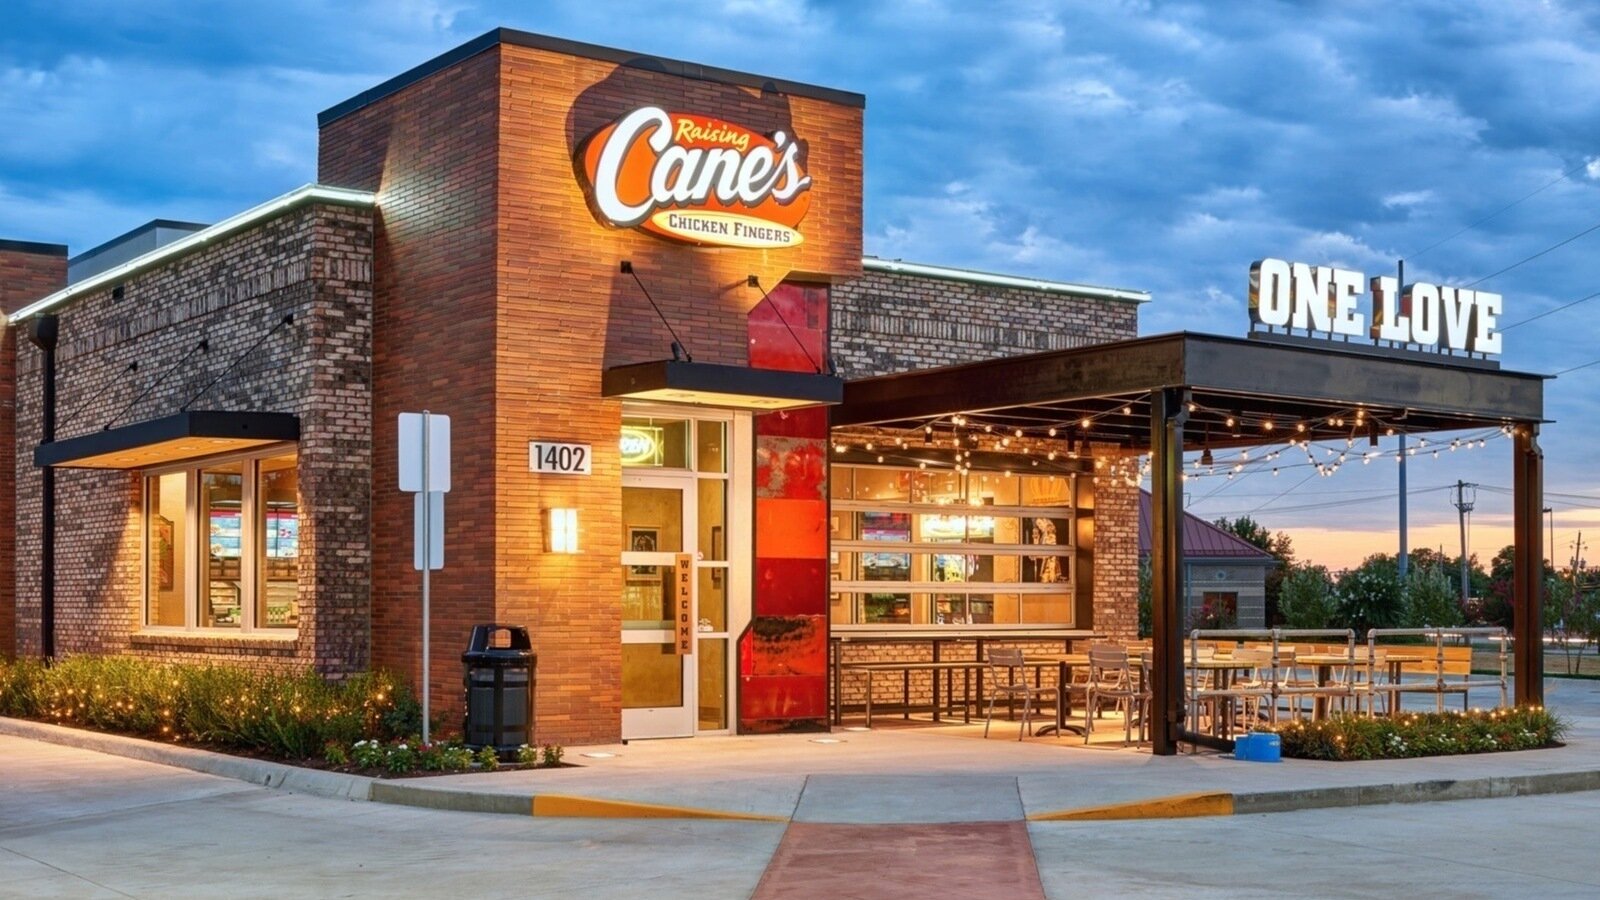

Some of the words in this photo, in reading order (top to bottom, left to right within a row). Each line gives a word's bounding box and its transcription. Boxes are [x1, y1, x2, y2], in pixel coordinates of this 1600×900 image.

[596, 106, 811, 222] Cane's
[676, 118, 750, 150] Raising
[668, 213, 729, 235] CHICKEN
[733, 221, 791, 243] FINGERS
[1250, 257, 1365, 336] ONE
[1371, 275, 1503, 355] LOVE
[534, 444, 586, 472] 1402
[680, 559, 690, 649] WELCOME
